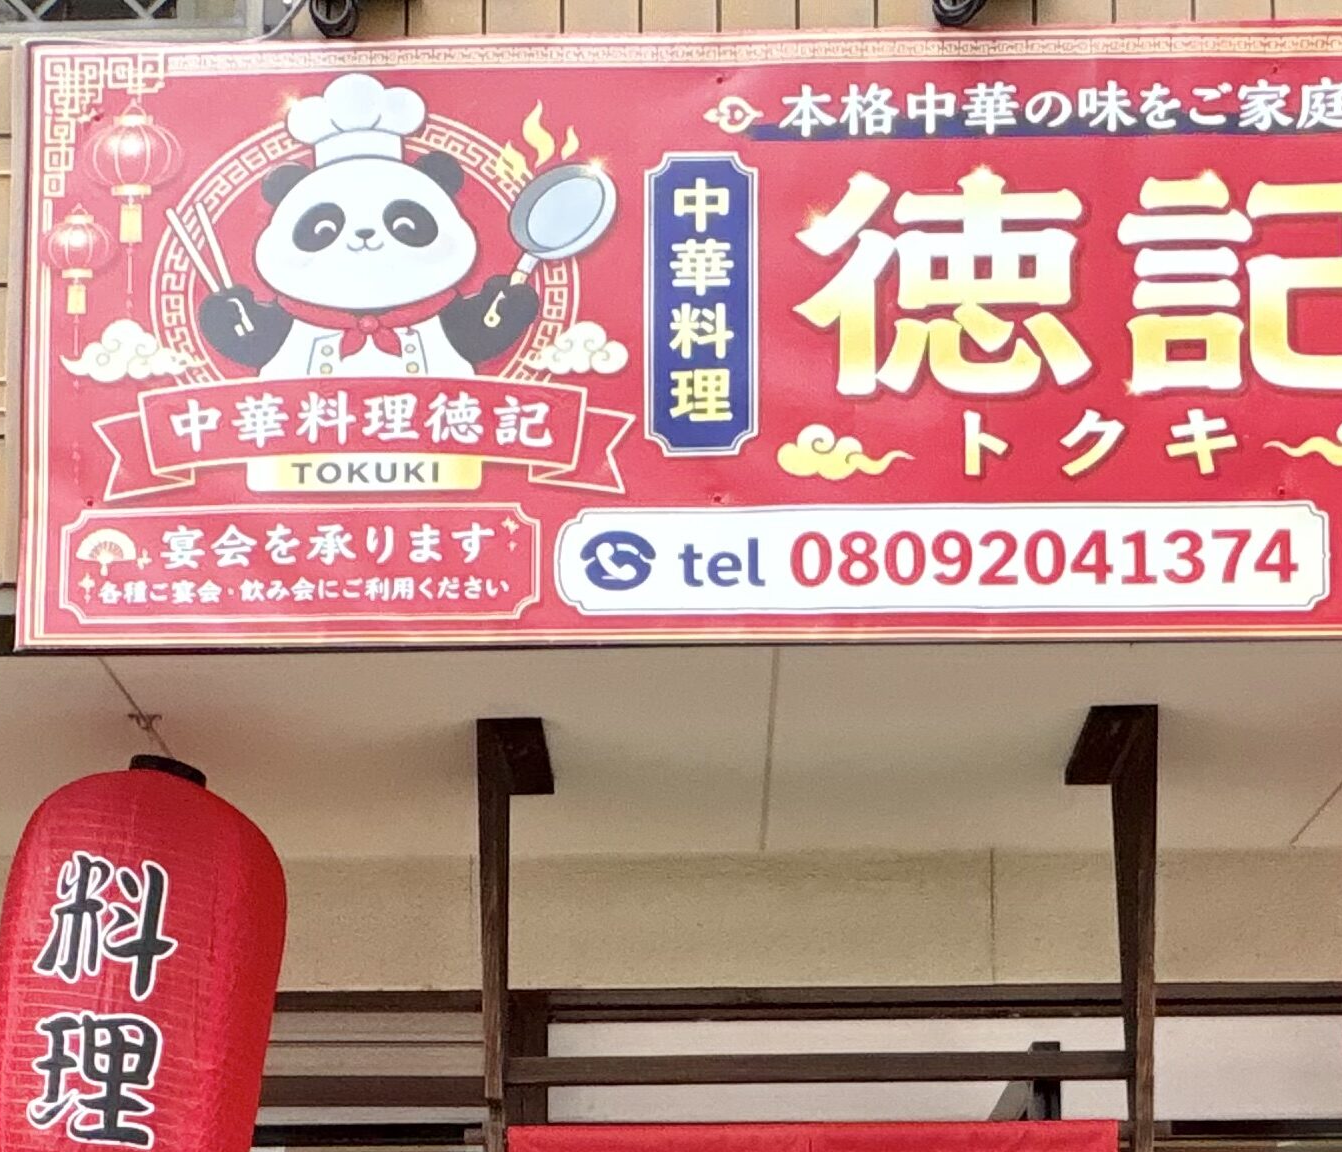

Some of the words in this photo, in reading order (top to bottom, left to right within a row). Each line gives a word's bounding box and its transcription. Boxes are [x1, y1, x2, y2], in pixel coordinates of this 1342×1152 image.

[667, 176, 735, 425] 中華料理
[171, 391, 555, 453] 中華料理徳記
[961, 407, 1243, 477] トクキ
[290, 461, 441, 485] TOKUKI
[159, 521, 496, 569] 宴会を承ります
[678, 535, 766, 588] tel
[789, 528, 1300, 589] 08092041374
[98, 576, 511, 604] 各種ご宴会・飲み会にご利用ください
[26, 850, 179, 1150] 料理
